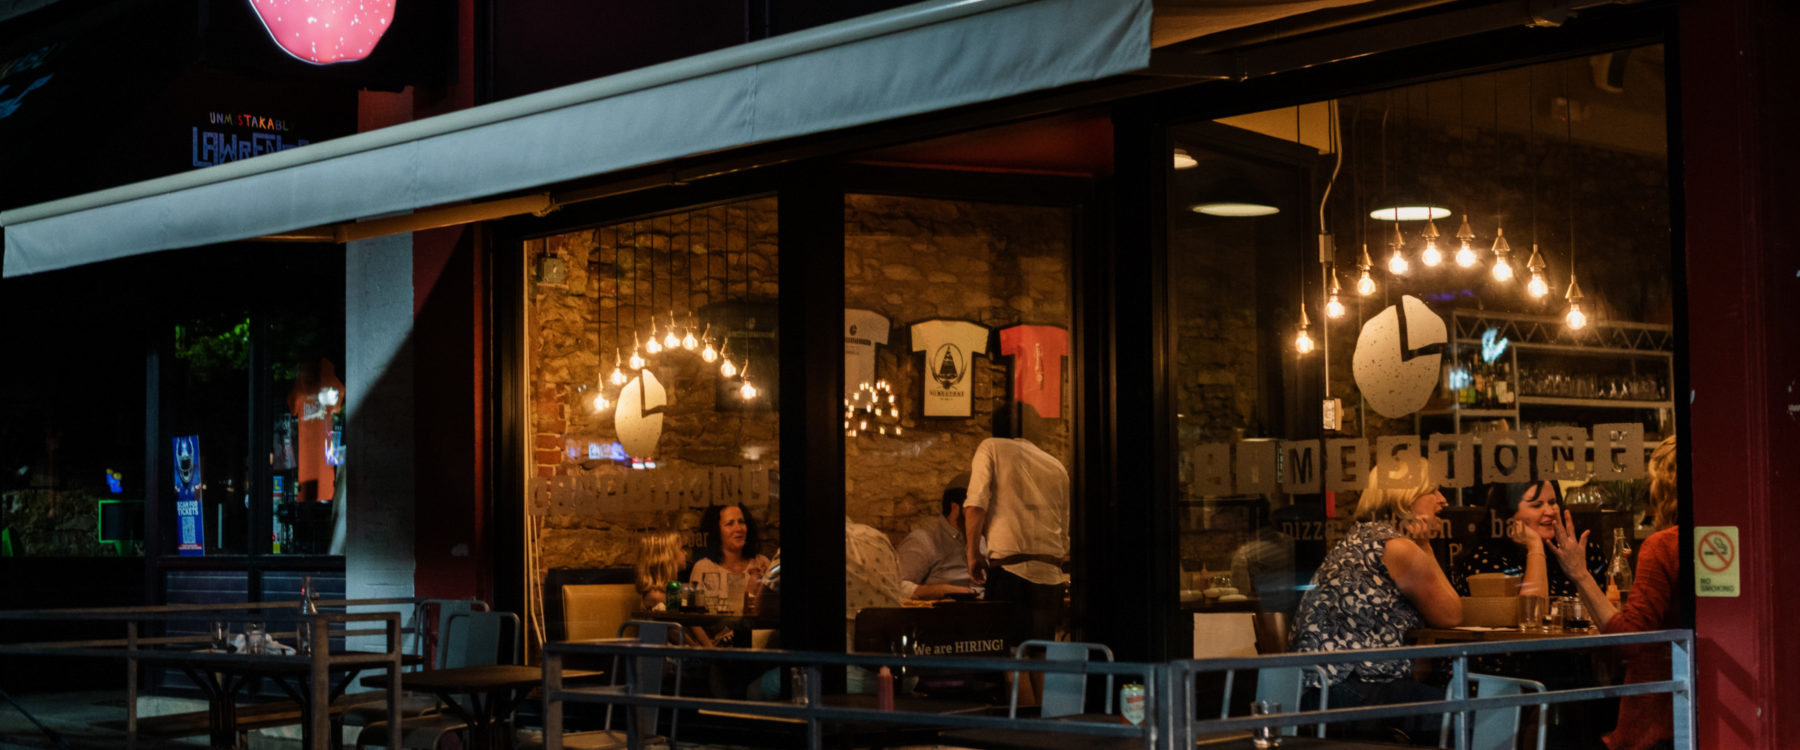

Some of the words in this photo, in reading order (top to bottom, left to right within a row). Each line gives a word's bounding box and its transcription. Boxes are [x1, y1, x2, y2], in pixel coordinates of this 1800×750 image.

[209, 111, 296, 132] UNMSTAKABL
[914, 643, 932, 656] We
[933, 644, 953, 655] are
[954, 639, 1004, 654] HIRING!
